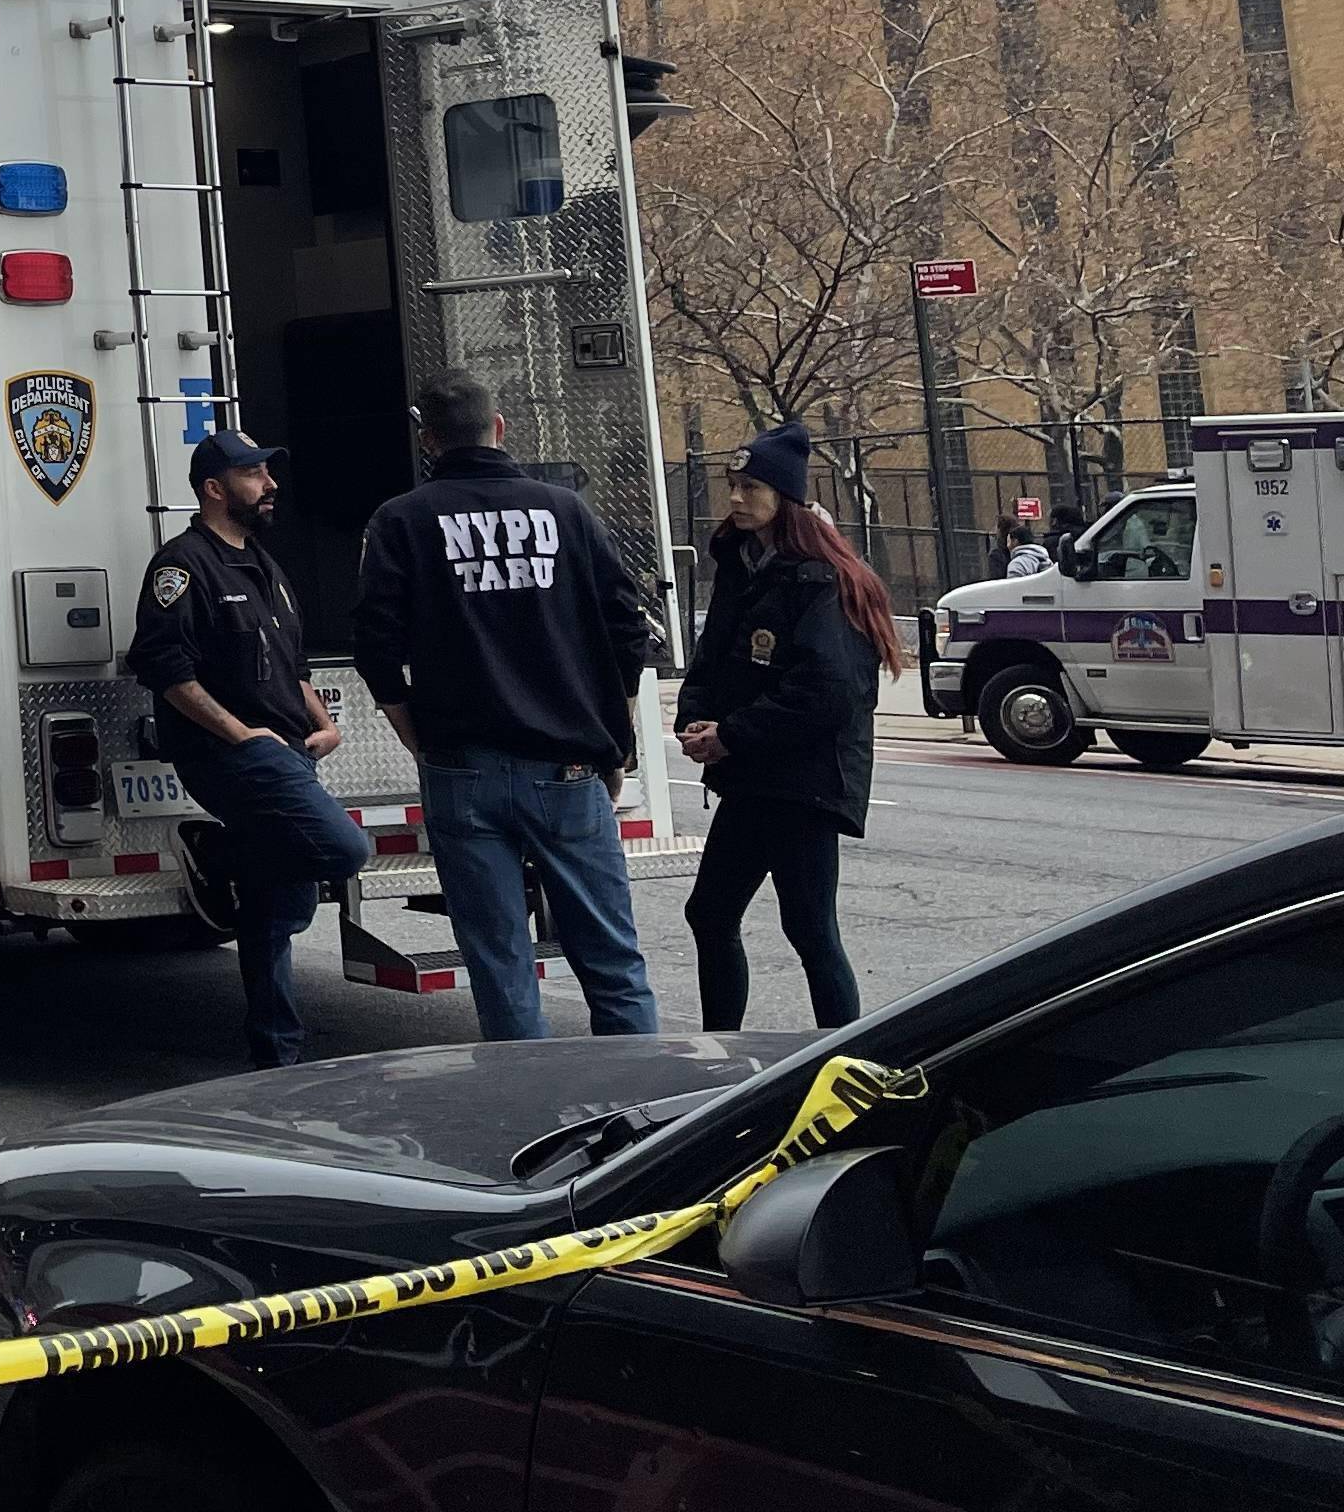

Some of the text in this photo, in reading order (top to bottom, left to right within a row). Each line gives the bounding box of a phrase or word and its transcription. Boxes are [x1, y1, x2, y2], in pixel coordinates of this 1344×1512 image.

[26, 376, 74, 394] POLICE
[11, 390, 90, 415] DEPARTMENT
[14, 429, 46, 481] CITY OF
[62, 421, 91, 488] NEW YORK
[1255, 480, 1289, 496] 1952
[438, 508, 560, 563] NYPD
[454, 556, 555, 594] TARU
[121, 774, 179, 804] 7035
